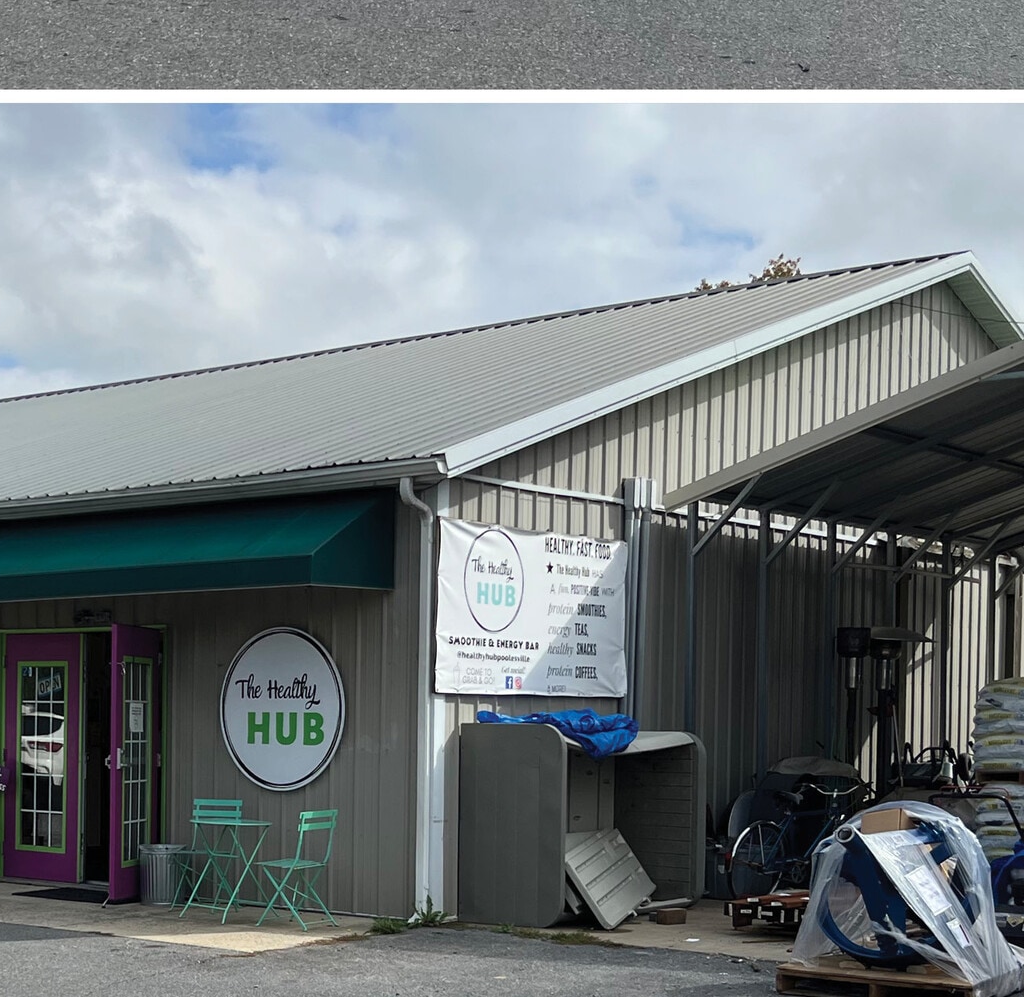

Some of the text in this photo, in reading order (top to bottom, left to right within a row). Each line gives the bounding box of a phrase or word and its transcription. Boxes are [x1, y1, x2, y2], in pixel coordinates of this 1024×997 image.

[471, 556, 515, 583] The Healthy
[476, 582, 516, 607] HUB
[547, 602, 575, 616] protein
[547, 624, 572, 638] energy
[448, 635, 539, 650] SMOOTHIE & ENERGY BAR
[547, 642, 597, 657] healthy SNACKS
[546, 665, 573, 679] protein
[235, 673, 321, 710] The Healthy
[247, 711, 325, 746] HUB
